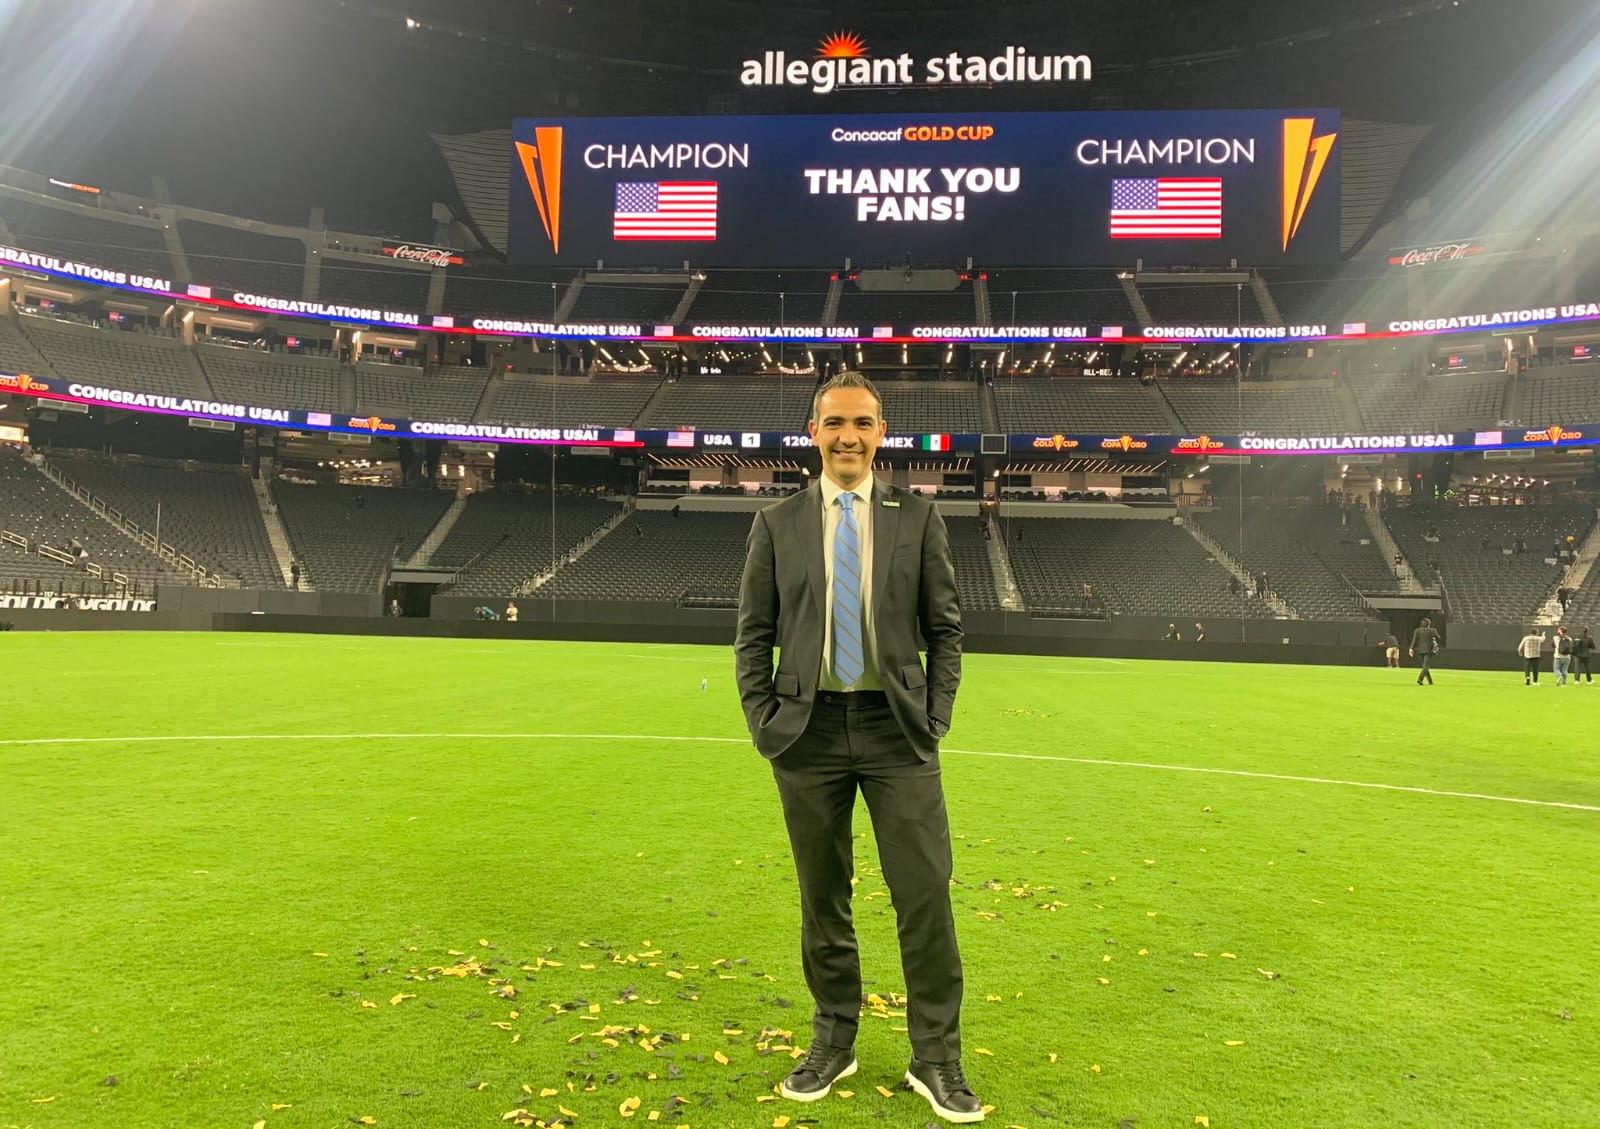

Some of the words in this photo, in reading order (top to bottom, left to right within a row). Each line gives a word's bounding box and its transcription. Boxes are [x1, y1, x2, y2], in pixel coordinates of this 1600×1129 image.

[740, 50, 914, 93] allegiant
[926, 46, 1092, 82] stadium
[831, 127, 903, 142] Concacaf
[904, 126, 955, 141] GOLD
[956, 126, 994, 140] CUP
[583, 142, 750, 170] CHAMPION
[1076, 137, 1255, 165] CHAMPION
[804, 168, 932, 194] THANK
[940, 167, 1021, 193] YOU
[857, 195, 965, 222] FANS!
[393, 245, 453, 267] Coca-Cola
[130, 275, 171, 291] USA!
[233, 292, 381, 321] CONGRATULATIONS
[384, 311, 419, 325] USA!
[473, 319, 607, 335] CONGRATULATIONS
[609, 325, 641, 336] USA!
[1389, 307, 1556, 332] CONGRATULATIONS
[692, 327, 823, 337] CONGRATULATIONS
[826, 327, 859, 337] USA!
[912, 327, 1049, 337] CONGRATULATIONS
[1053, 327, 1087, 337] USA!
[1143, 327, 1285, 338] CONGRATULATIONS
[1290, 325, 1327, 336] USA!
[29, 382, 49, 391] CUP
[68, 383, 245, 417] CONGRATULATIONS
[249, 407, 289, 422] USA!
[410, 422, 560, 440] CONGRATULATIONS
[563, 429, 599, 441] USA!
[1523, 433, 1549, 441] COPA
[703, 434, 733, 446] USA
[747, 436, 755, 445] 1
[782, 435, 813, 447] 120:
[882, 436, 914, 448] MEX
[1240, 434, 1406, 450] CONGRATULATIONS
[1411, 434, 1453, 447] USA!
